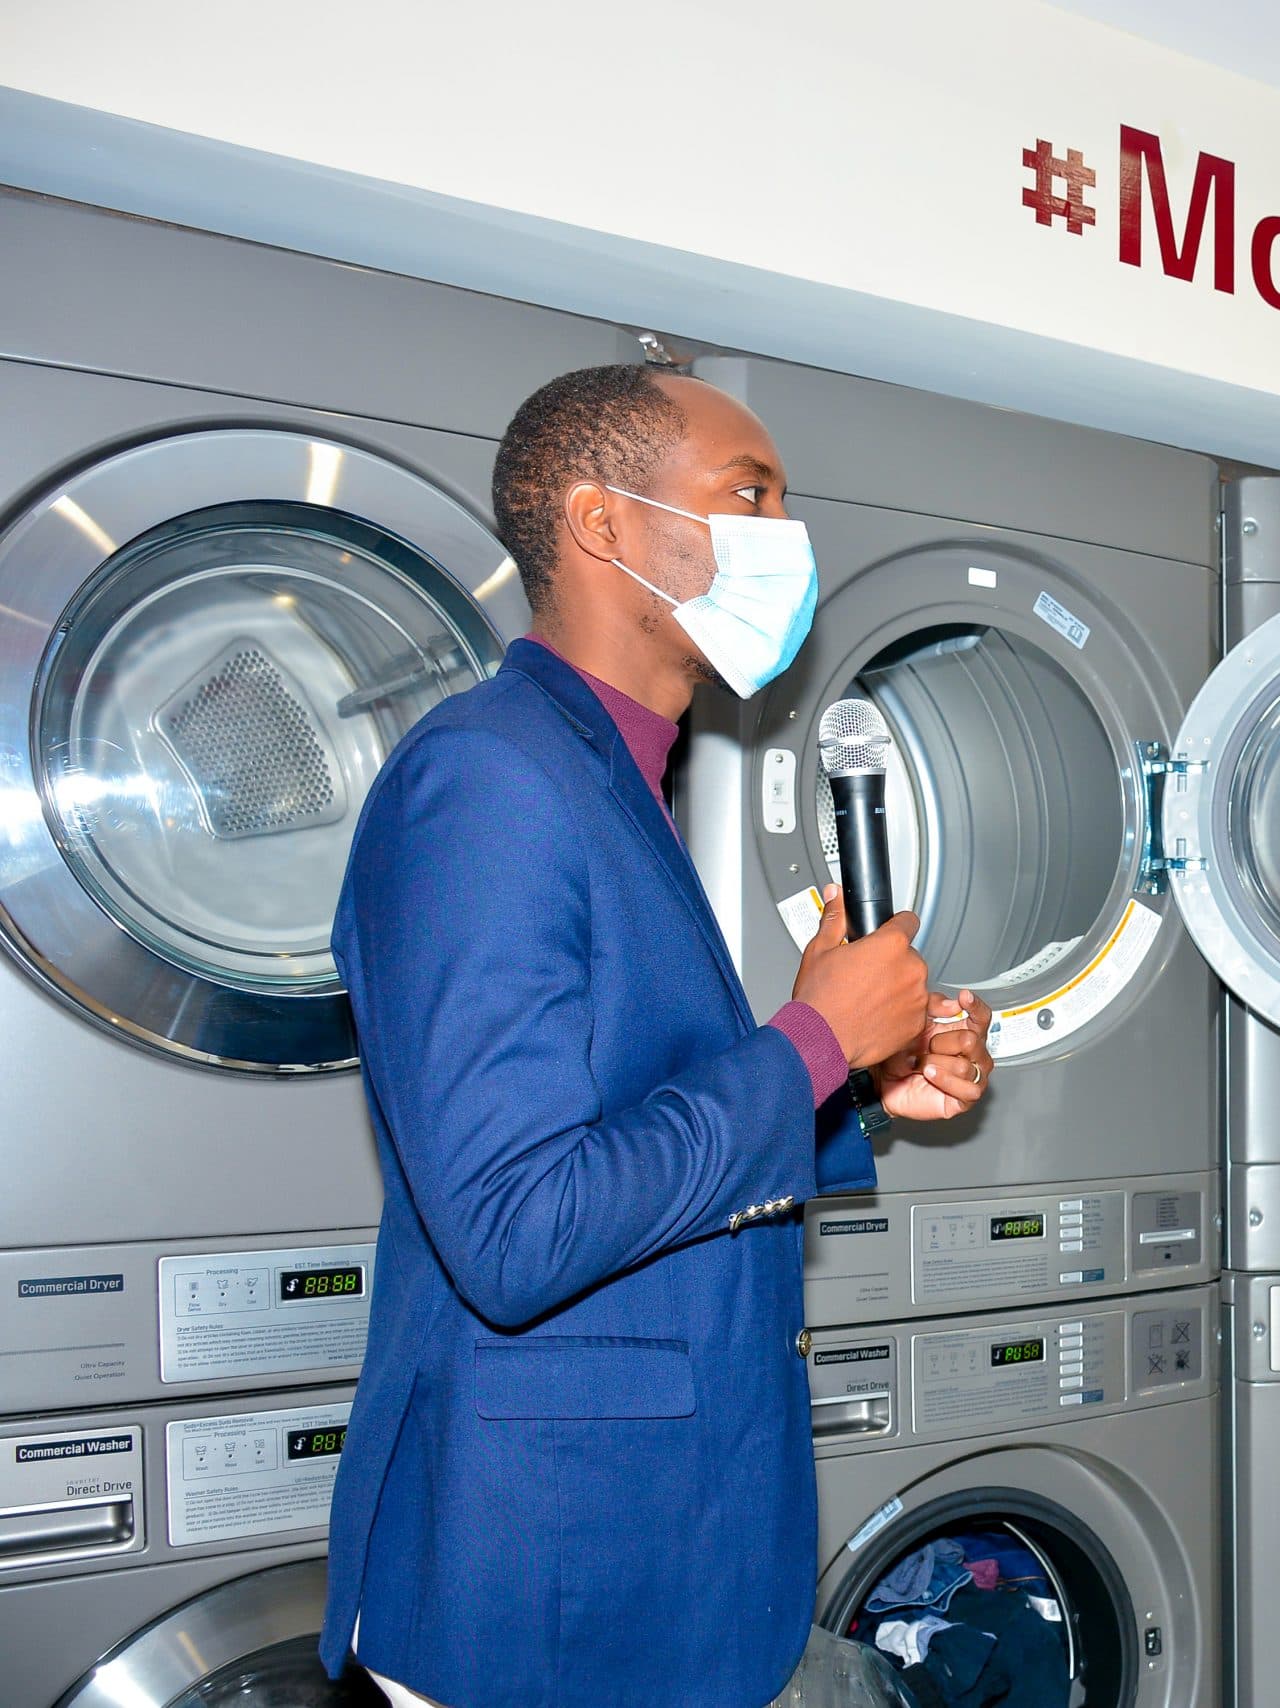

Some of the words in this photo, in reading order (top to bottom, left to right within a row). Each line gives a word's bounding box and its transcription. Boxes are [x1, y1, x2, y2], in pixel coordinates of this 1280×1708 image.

[821, 1223, 864, 1233] Commercial
[866, 1221, 887, 1231] Dryer
[206, 1268, 238, 1276] Processing
[20, 1279, 87, 1294] Commercial
[89, 1278, 120, 1292] Dryer
[816, 1352, 859, 1363] Commercial
[860, 1349, 888, 1359] Washer
[846, 1384, 868, 1392] Direct
[870, 1382, 889, 1390] Drive
[214, 1430, 246, 1438] Processing
[19, 1445, 85, 1460] Commercial
[87, 1440, 130, 1452] Washer
[67, 1484, 100, 1496] Direct
[103, 1481, 132, 1492] Drive
